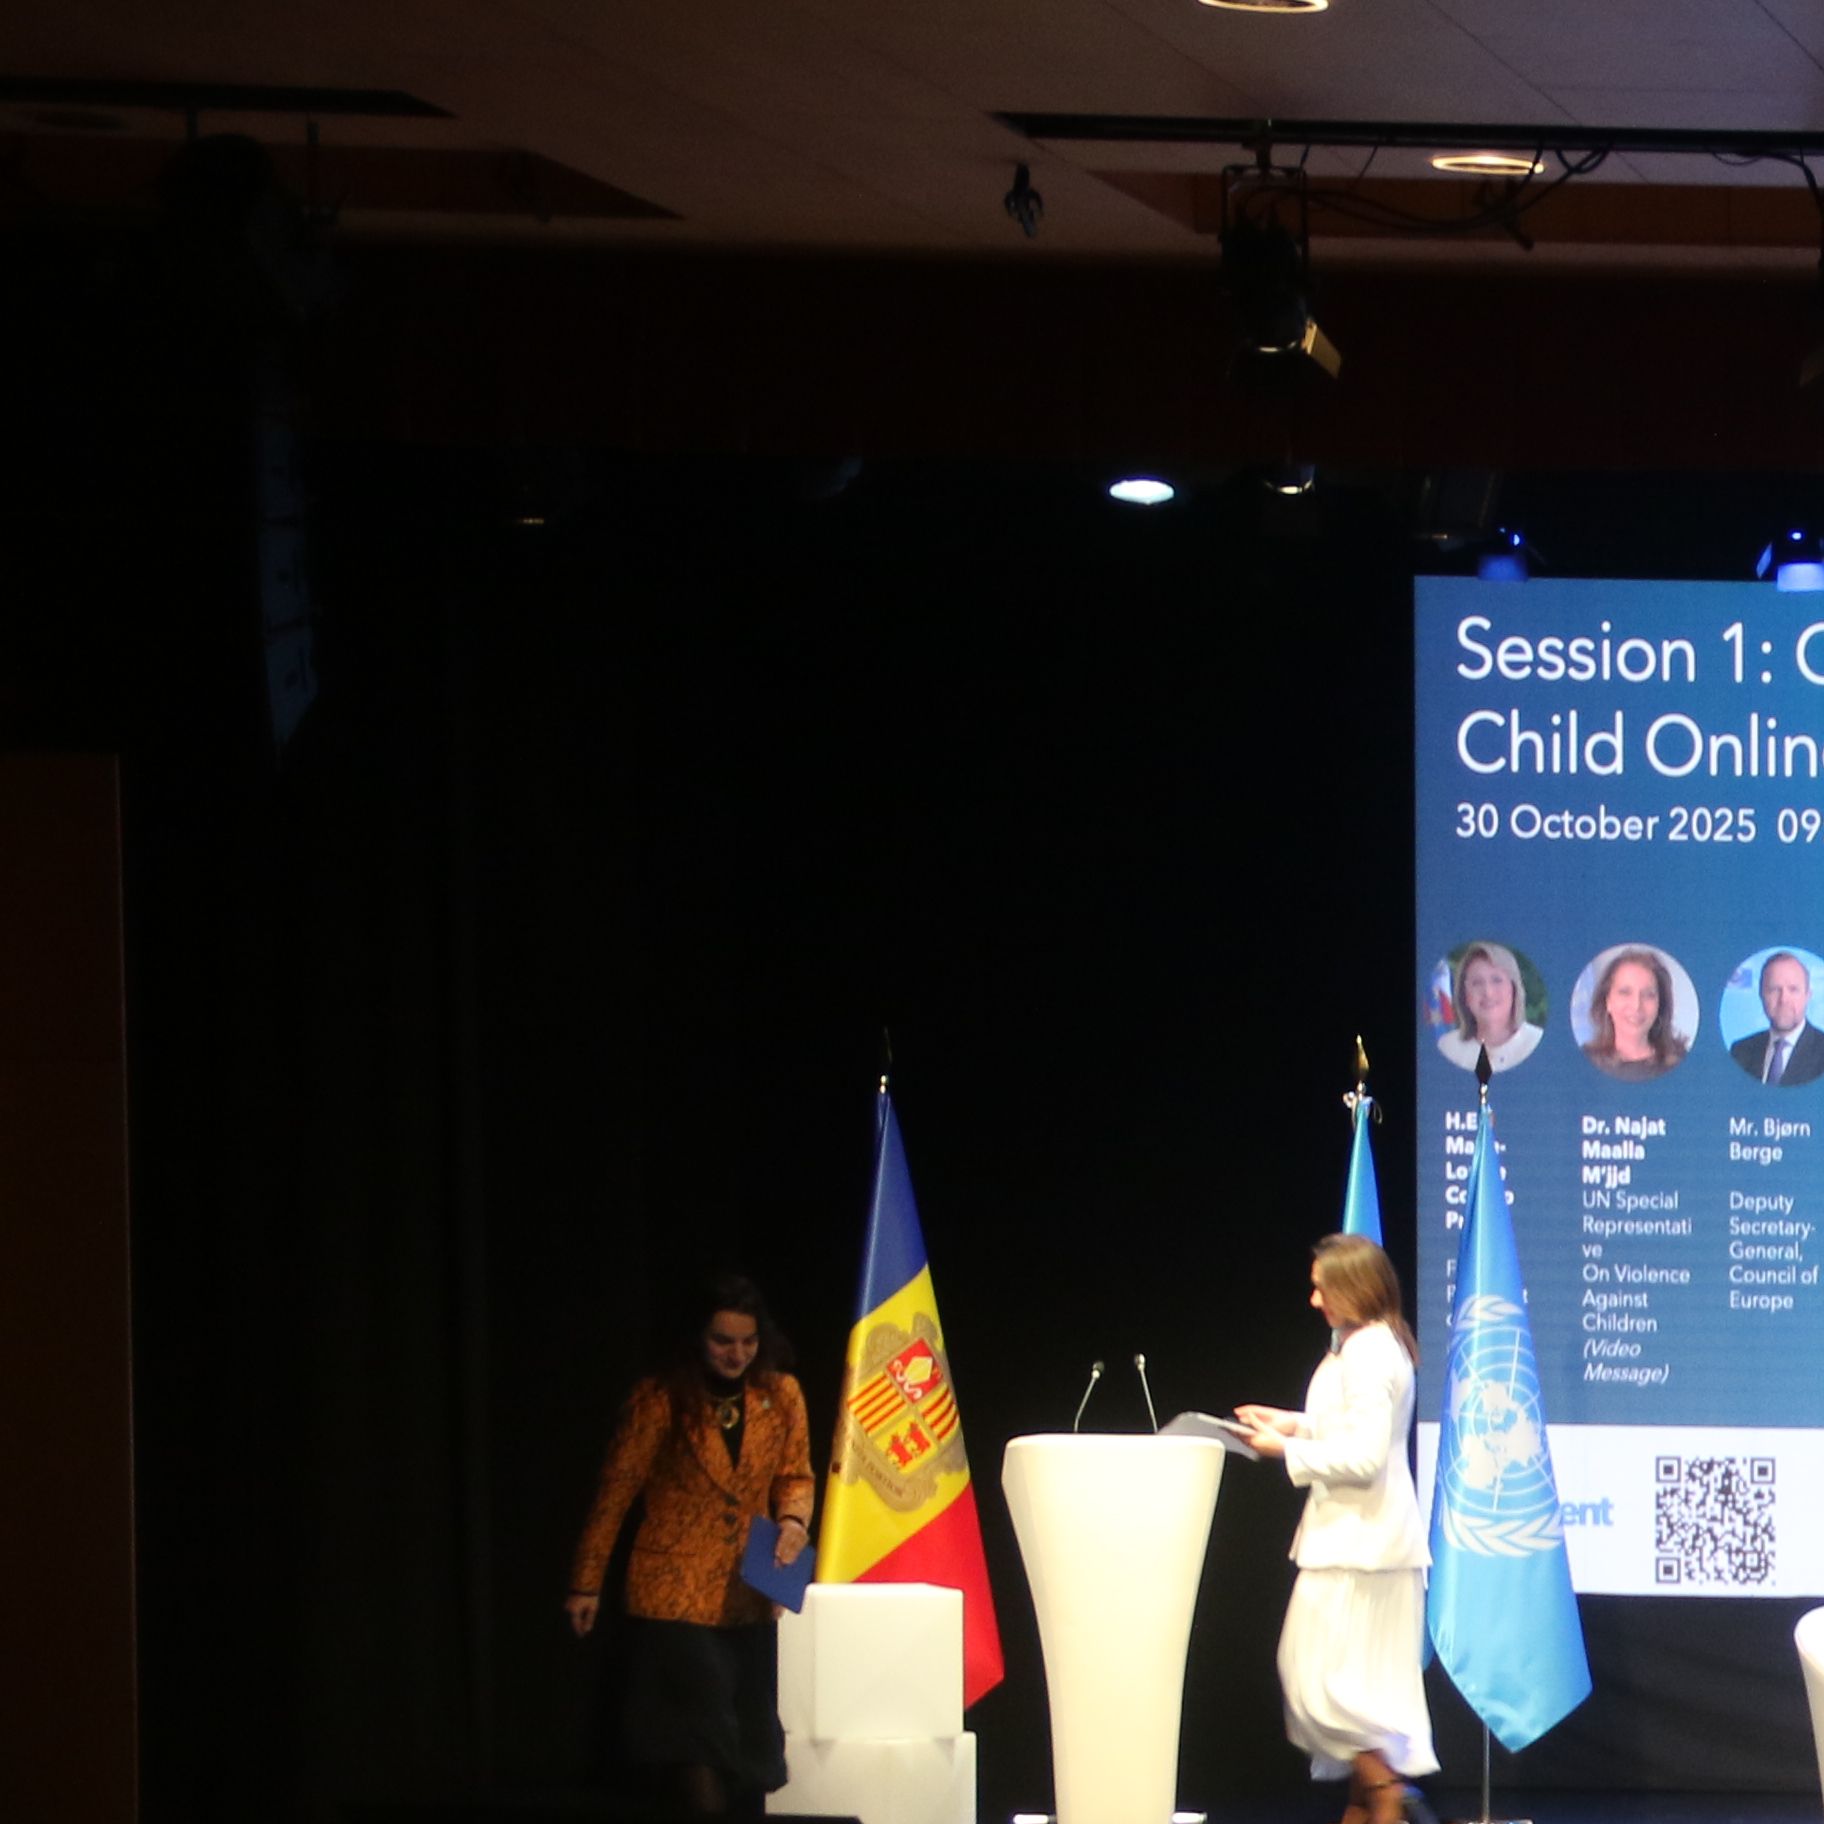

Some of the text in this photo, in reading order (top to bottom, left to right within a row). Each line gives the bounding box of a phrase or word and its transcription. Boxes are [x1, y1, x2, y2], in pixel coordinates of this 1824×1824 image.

[1458, 616, 1695, 682] Session
[1723, 622, 1771, 683] 1:
[1457, 710, 1623, 775] Child
[1456, 802, 1498, 838] 30
[1510, 803, 1658, 842] October
[1669, 806, 1757, 843] 2025
[1445, 1112, 1478, 1131] H.E
[1582, 1115, 1664, 1141] Dr. Najat
[1730, 1116, 1810, 1142] Mr. Bjørn
[1582, 1139, 1644, 1160] Maalla
[1730, 1141, 1782, 1167] Berge
[1730, 1215, 1814, 1241] Secretary-
[1729, 1264, 1819, 1285] Council of
[1730, 1289, 1793, 1315] Europe
